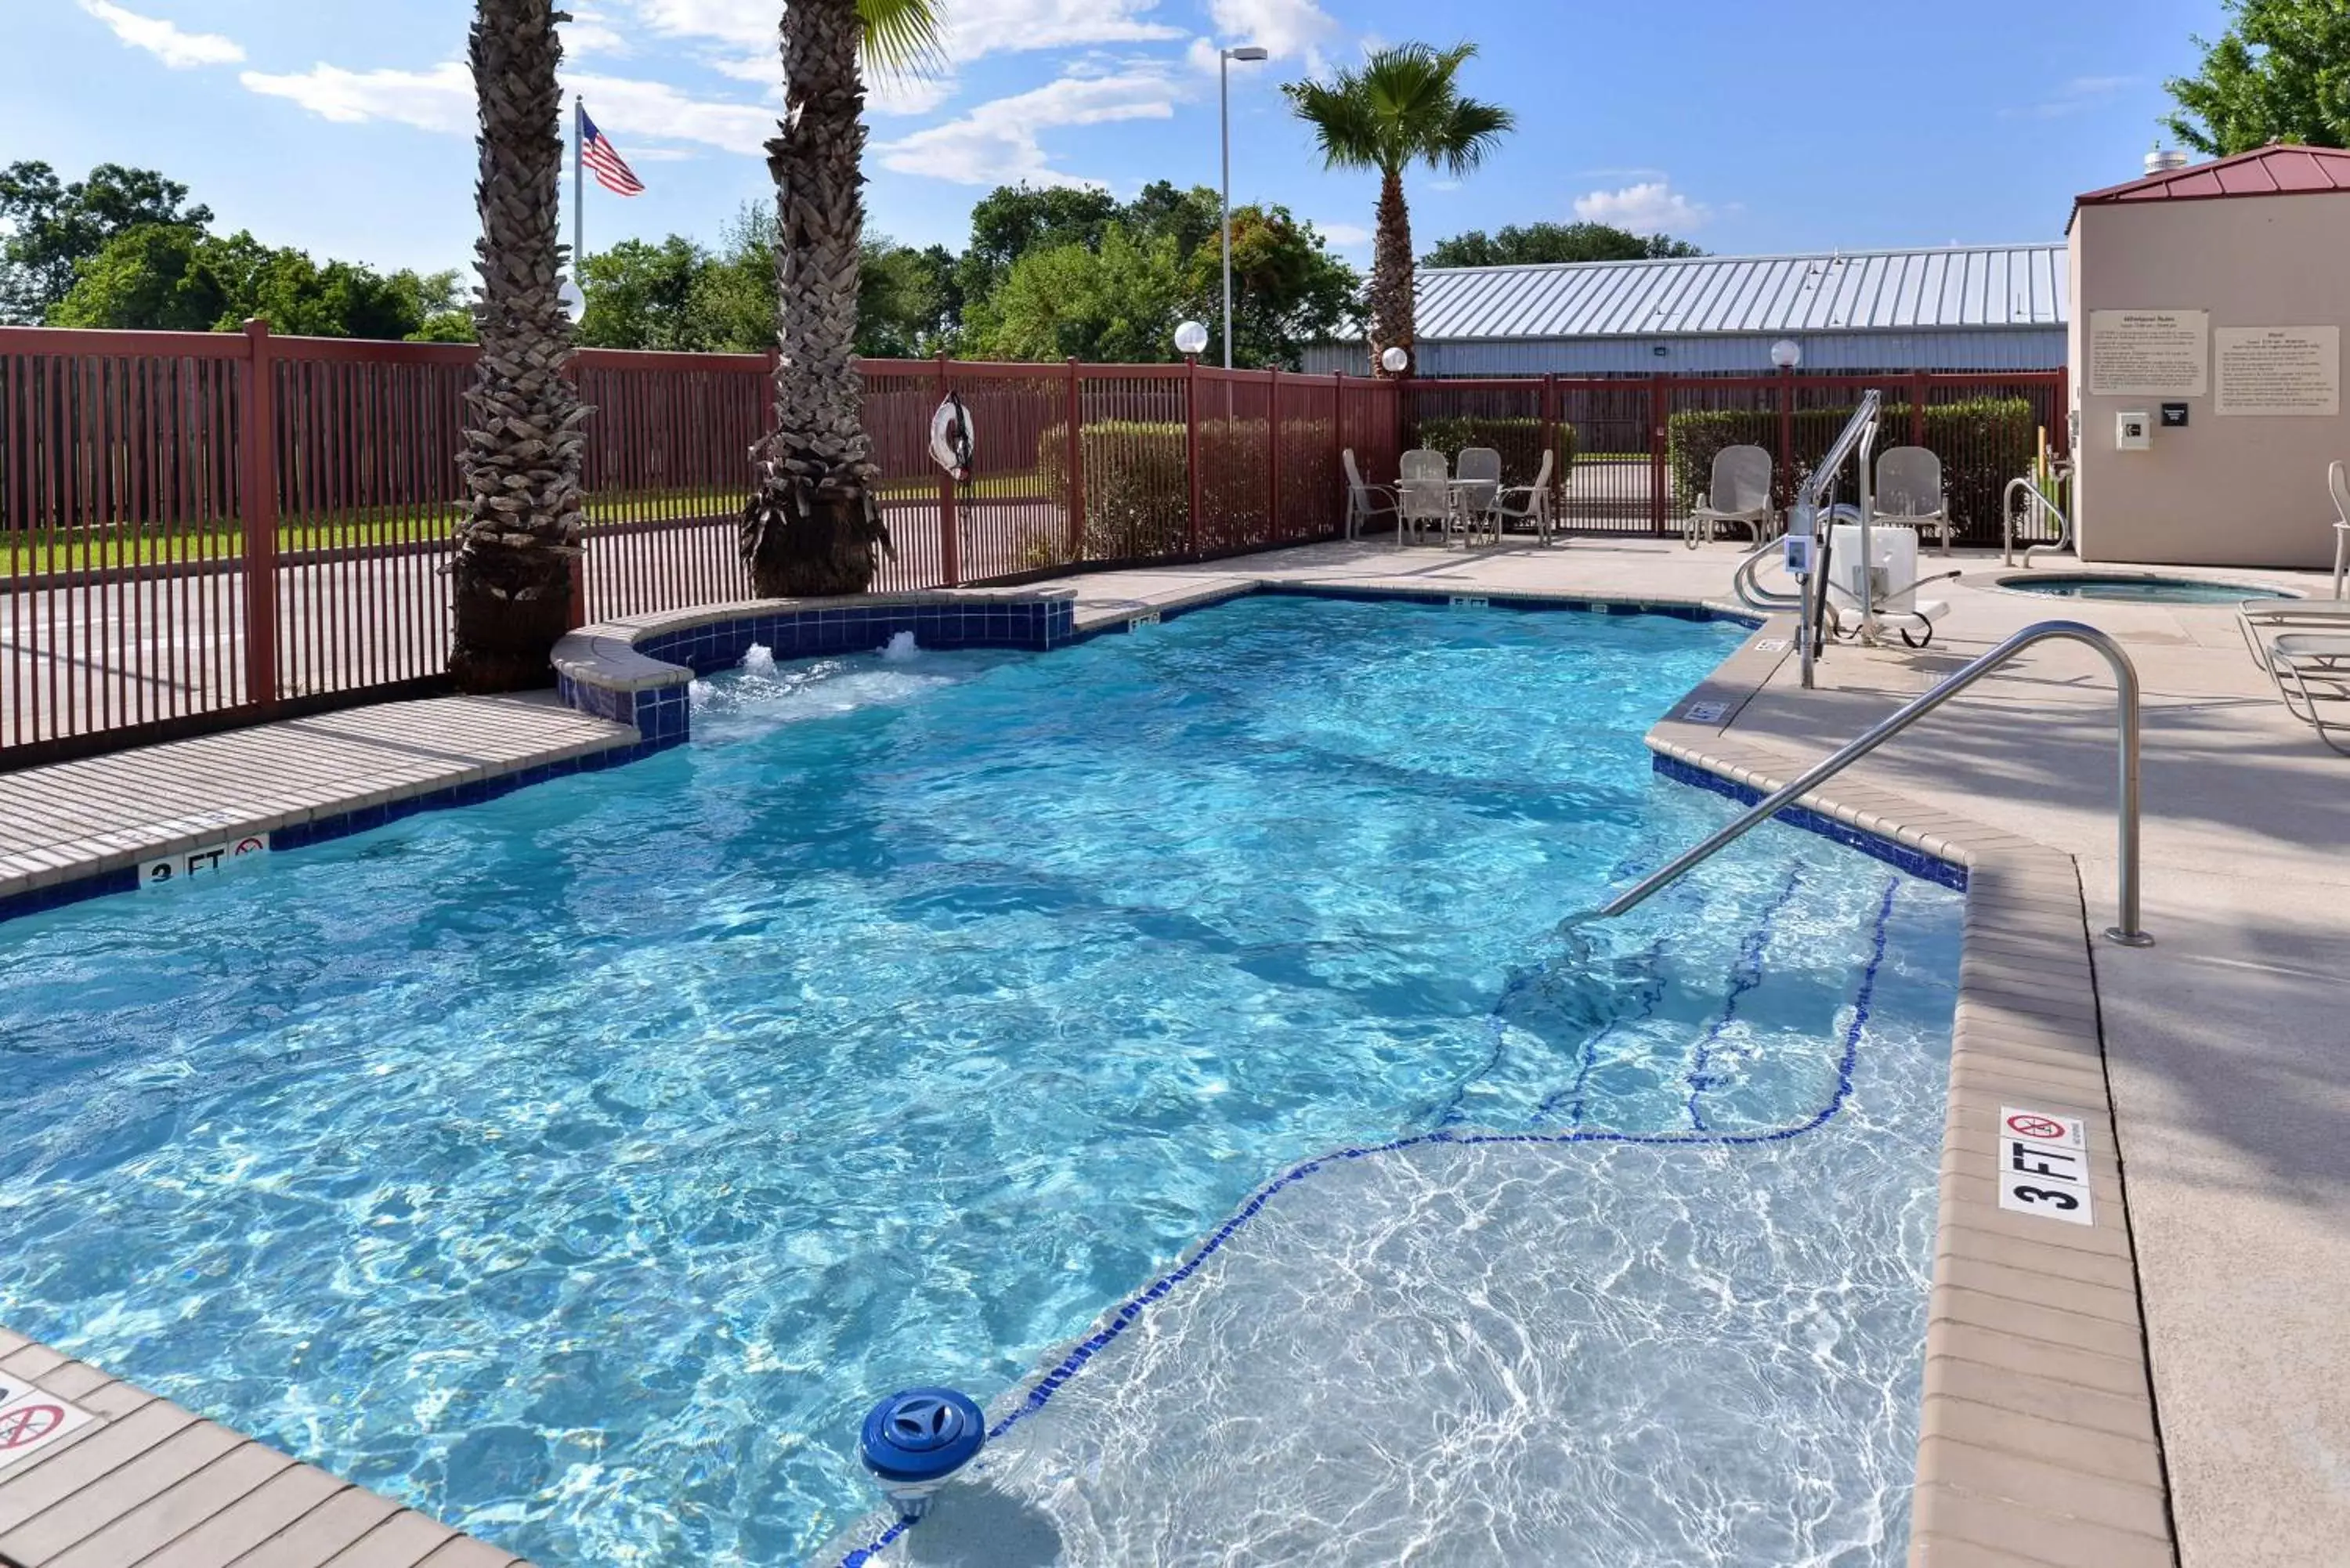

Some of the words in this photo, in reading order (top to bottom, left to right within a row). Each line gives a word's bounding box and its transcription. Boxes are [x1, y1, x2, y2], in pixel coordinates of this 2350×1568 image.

[188, 848, 225, 876] FT
[2013, 1143, 2077, 1180] FT
[2014, 1186, 2078, 1209] 3
